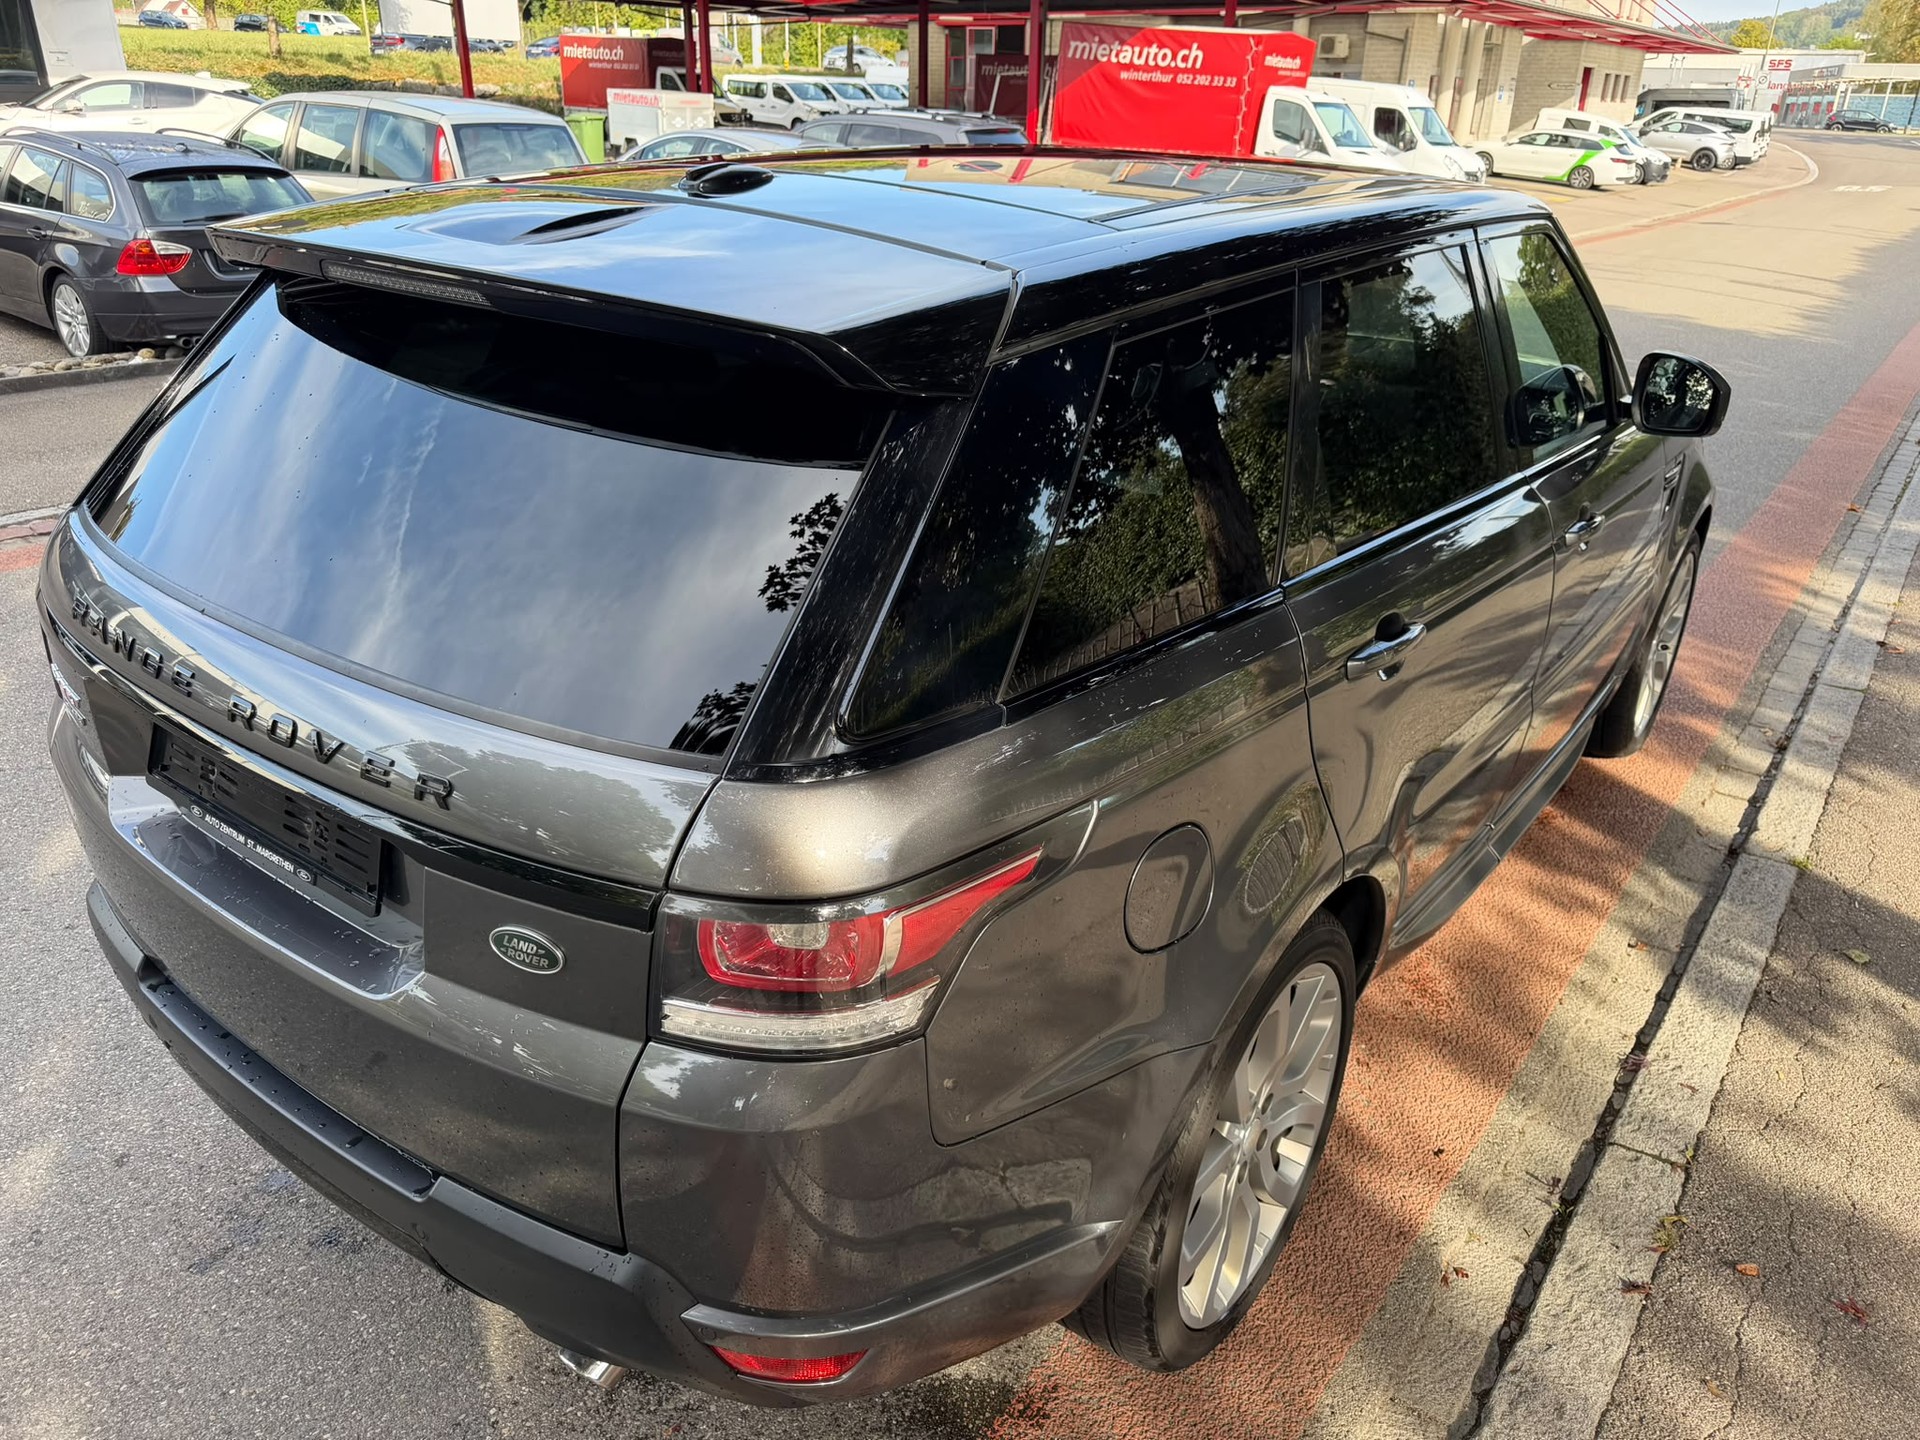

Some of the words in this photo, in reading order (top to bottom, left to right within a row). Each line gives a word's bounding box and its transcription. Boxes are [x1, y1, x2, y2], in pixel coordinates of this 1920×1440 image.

[563, 43, 624, 60] mietauto.ch
[1067, 36, 1203, 69] mietauto.ch
[1768, 59, 1793, 68] SFS
[1119, 69, 1172, 83] winterthur
[1176, 74, 1191, 85] 052
[1191, 75, 1211, 86] 202
[1212, 76, 1224, 87] 33
[1224, 77, 1237, 88] 33
[613, 92, 660, 107] mietauto.ch
[72, 595, 196, 698] RANGE
[227, 695, 455, 811] ROVER
[204, 813, 220, 829] AUTO
[219, 822, 245, 844] ZENTRUM
[502, 935, 537, 955] LAND
[507, 947, 549, 968] ROVER
